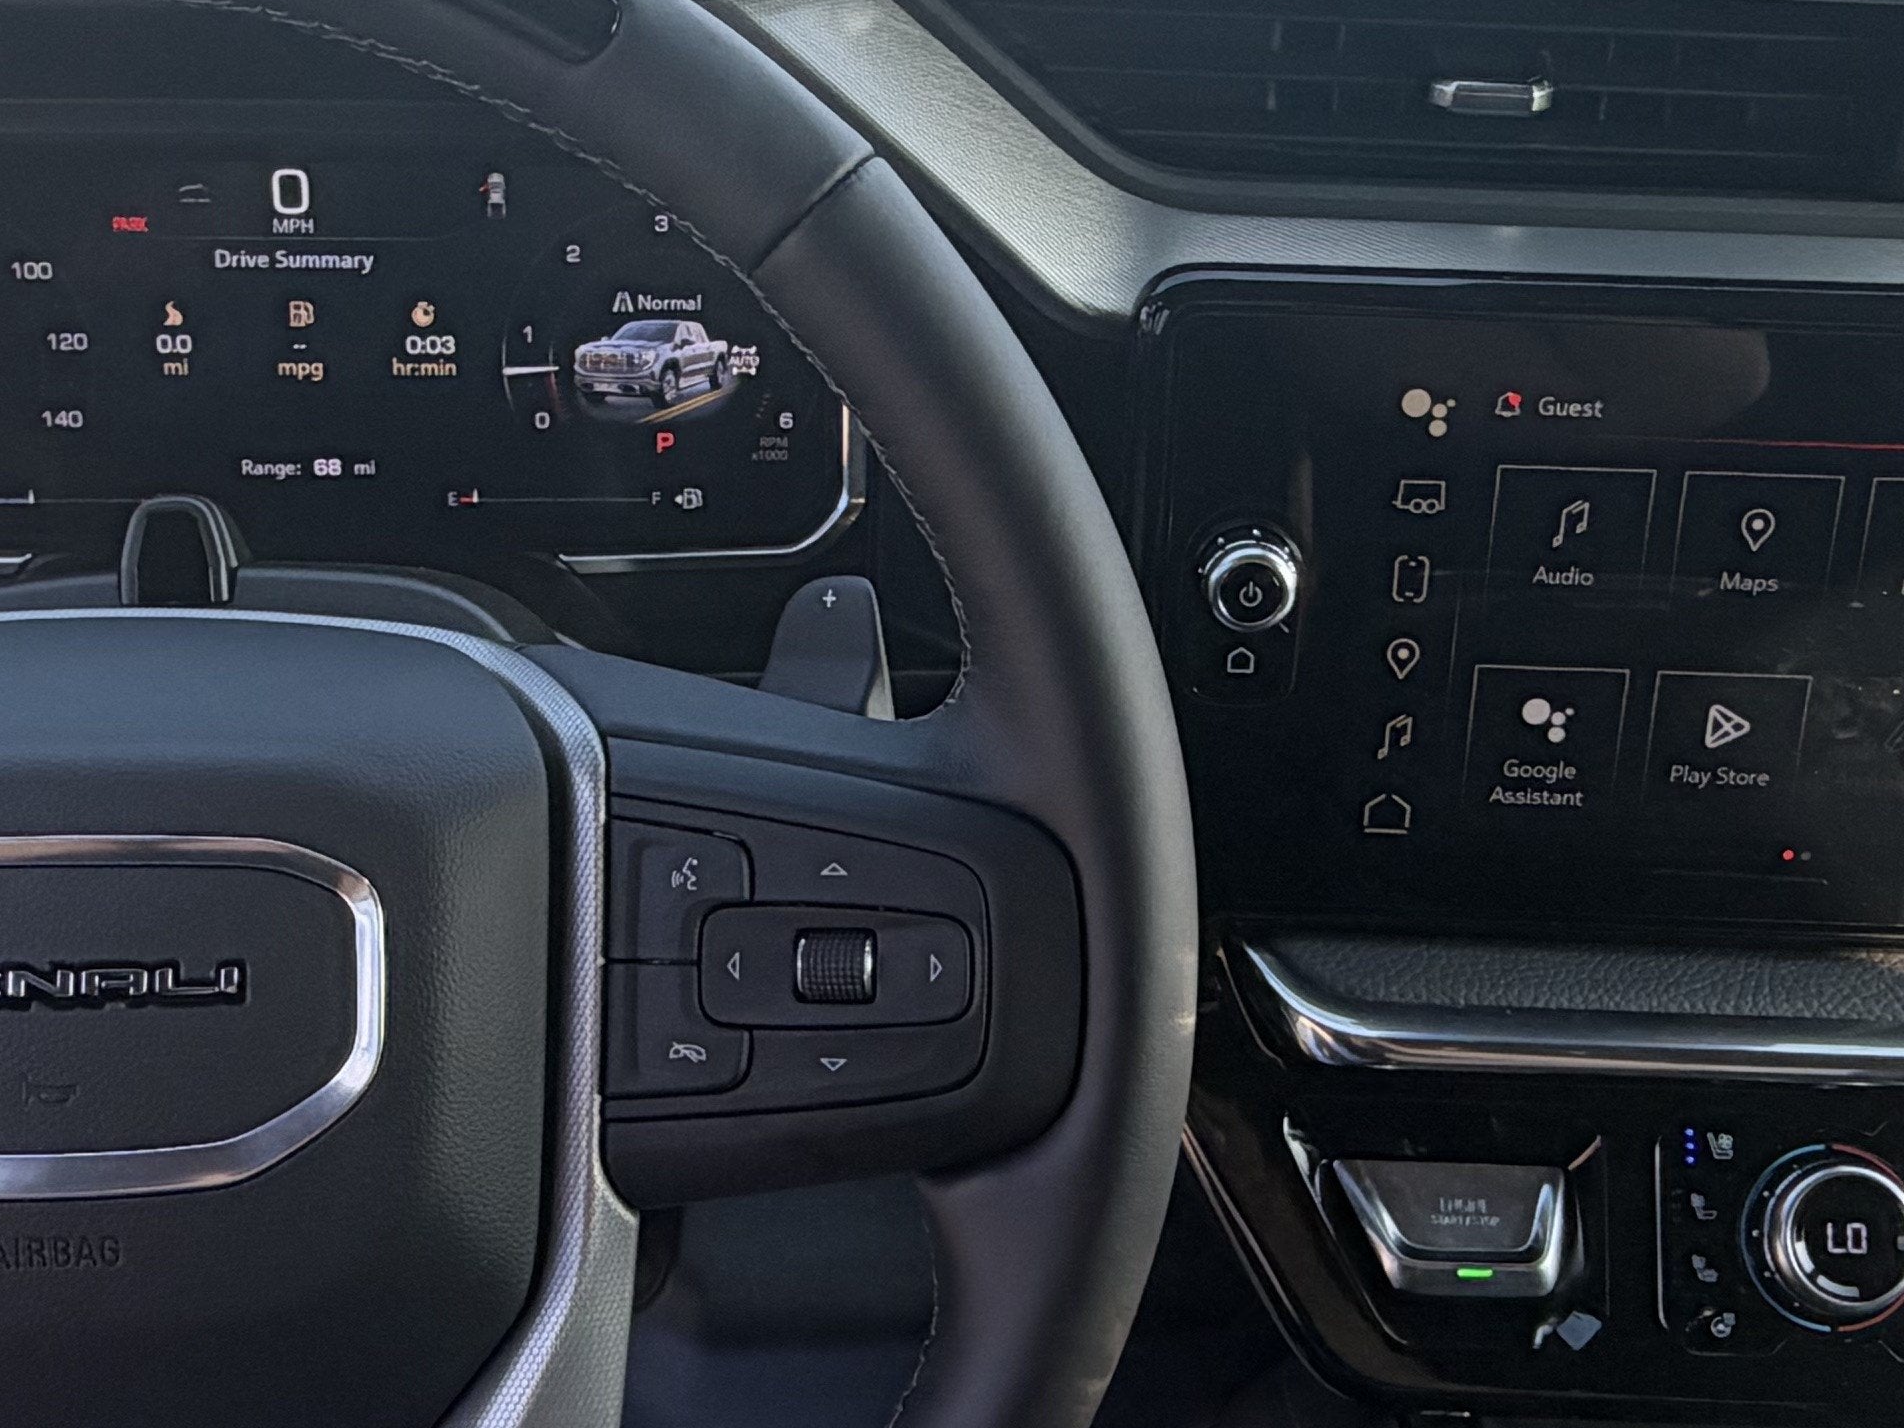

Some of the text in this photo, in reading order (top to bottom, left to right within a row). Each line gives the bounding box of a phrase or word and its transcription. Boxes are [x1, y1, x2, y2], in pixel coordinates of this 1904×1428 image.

[271, 169, 310, 215] 0
[272, 218, 314, 235] MPH
[654, 214, 669, 233] 3
[214, 249, 374, 274] Drive Summary
[565, 244, 581, 263] 2
[10, 262, 53, 280] 100
[636, 294, 703, 312] Normal
[46, 332, 89, 351] 120
[155, 334, 193, 355] 0.0
[522, 325, 534, 344] 1
[404, 335, 456, 355] 0:03
[163, 357, 189, 376] mi
[277, 360, 324, 381] mpg
[391, 357, 457, 377] hr:min
[1538, 397, 1604, 419] Guest
[41, 410, 84, 428] 140
[534, 412, 551, 430] 0
[779, 412, 794, 430] 6
[655, 431, 676, 454] P
[241, 458, 376, 480] Range: 68 mi
[447, 492, 459, 506] E
[650, 491, 661, 506] F
[1532, 565, 1594, 587] Audio
[1719, 573, 1779, 596] Maps
[1502, 759, 1577, 784] Google
[1669, 767, 1771, 789] Play Store
[1489, 786, 1584, 809] Assistant
